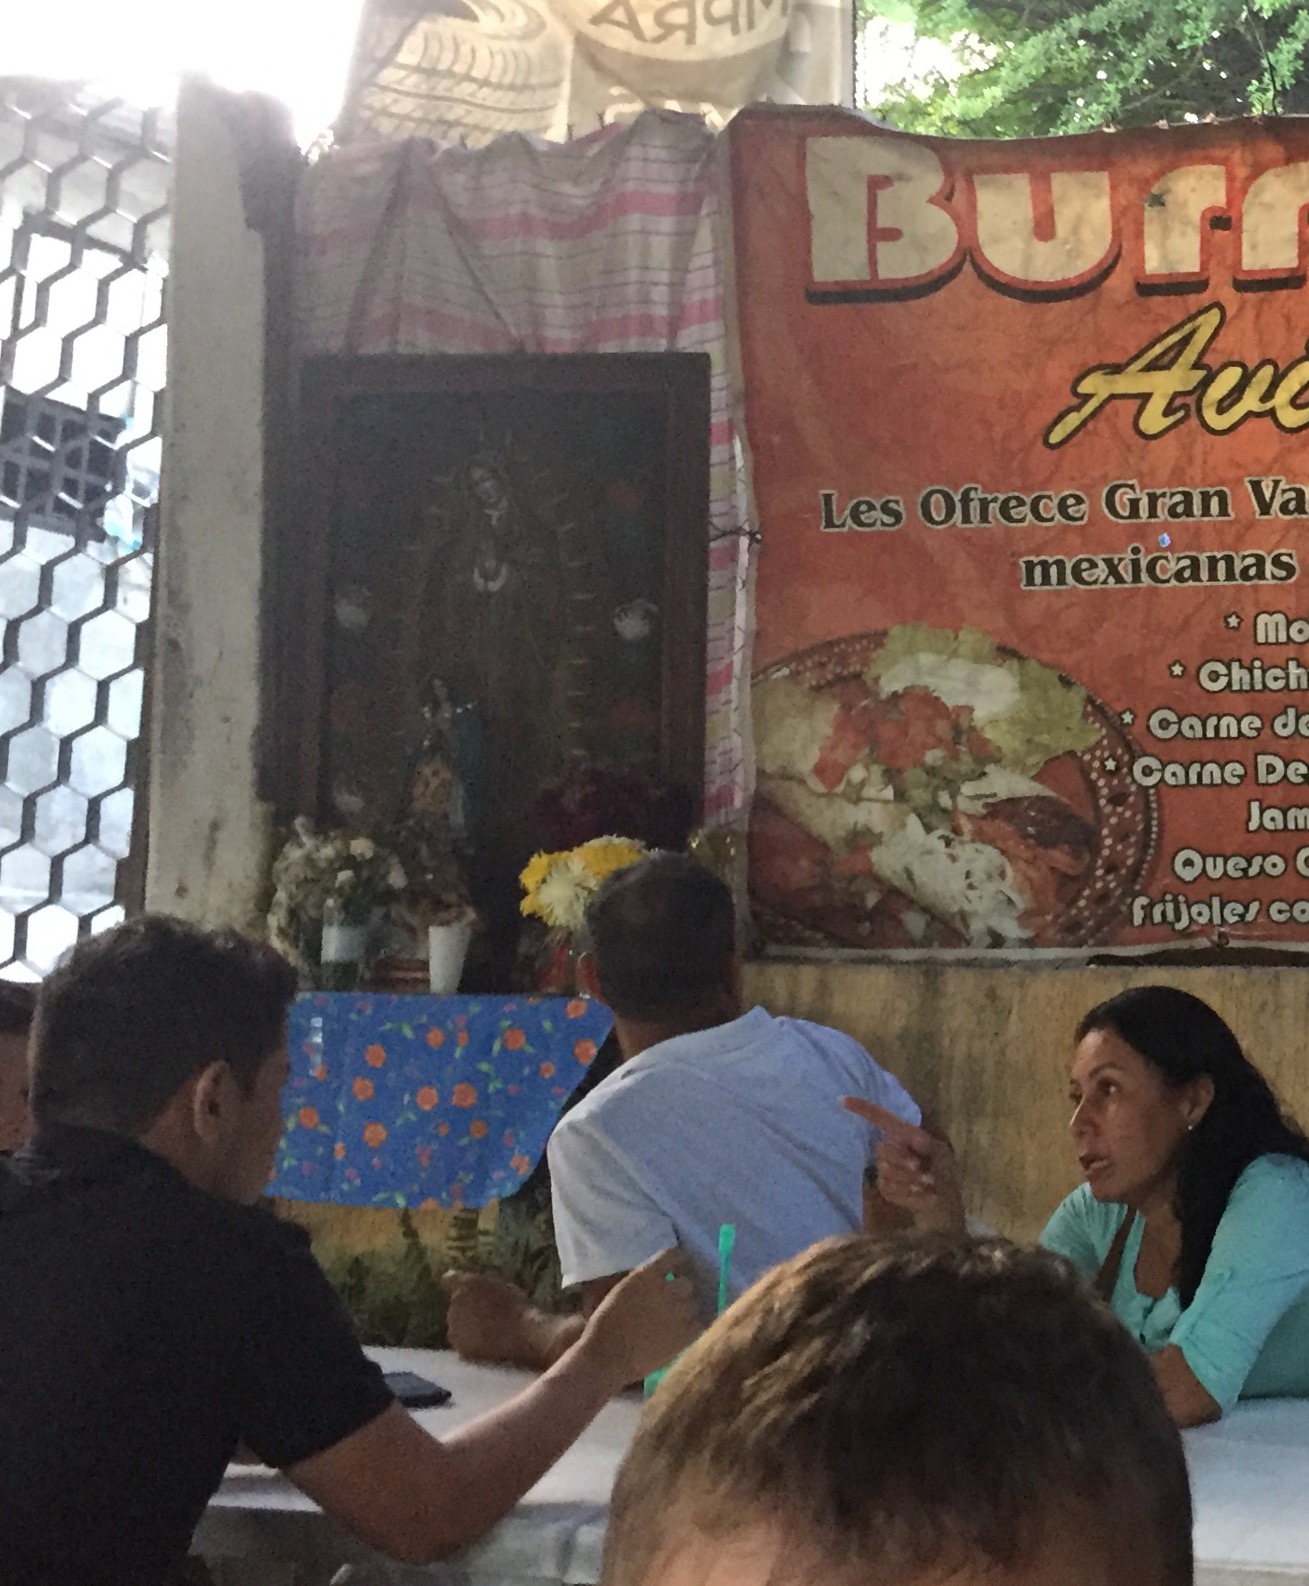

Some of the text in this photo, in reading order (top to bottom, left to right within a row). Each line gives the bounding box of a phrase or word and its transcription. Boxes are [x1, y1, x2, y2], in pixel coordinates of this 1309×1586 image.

[820, 491, 903, 530] Les
[919, 485, 1088, 529] Ofrece
[1103, 481, 1232, 522] Gran
[1020, 546, 1298, 588] mexicanas
[1148, 708, 1263, 739] Carne
[1132, 755, 1246, 787] Carne
[1172, 847, 1287, 882] Queso
